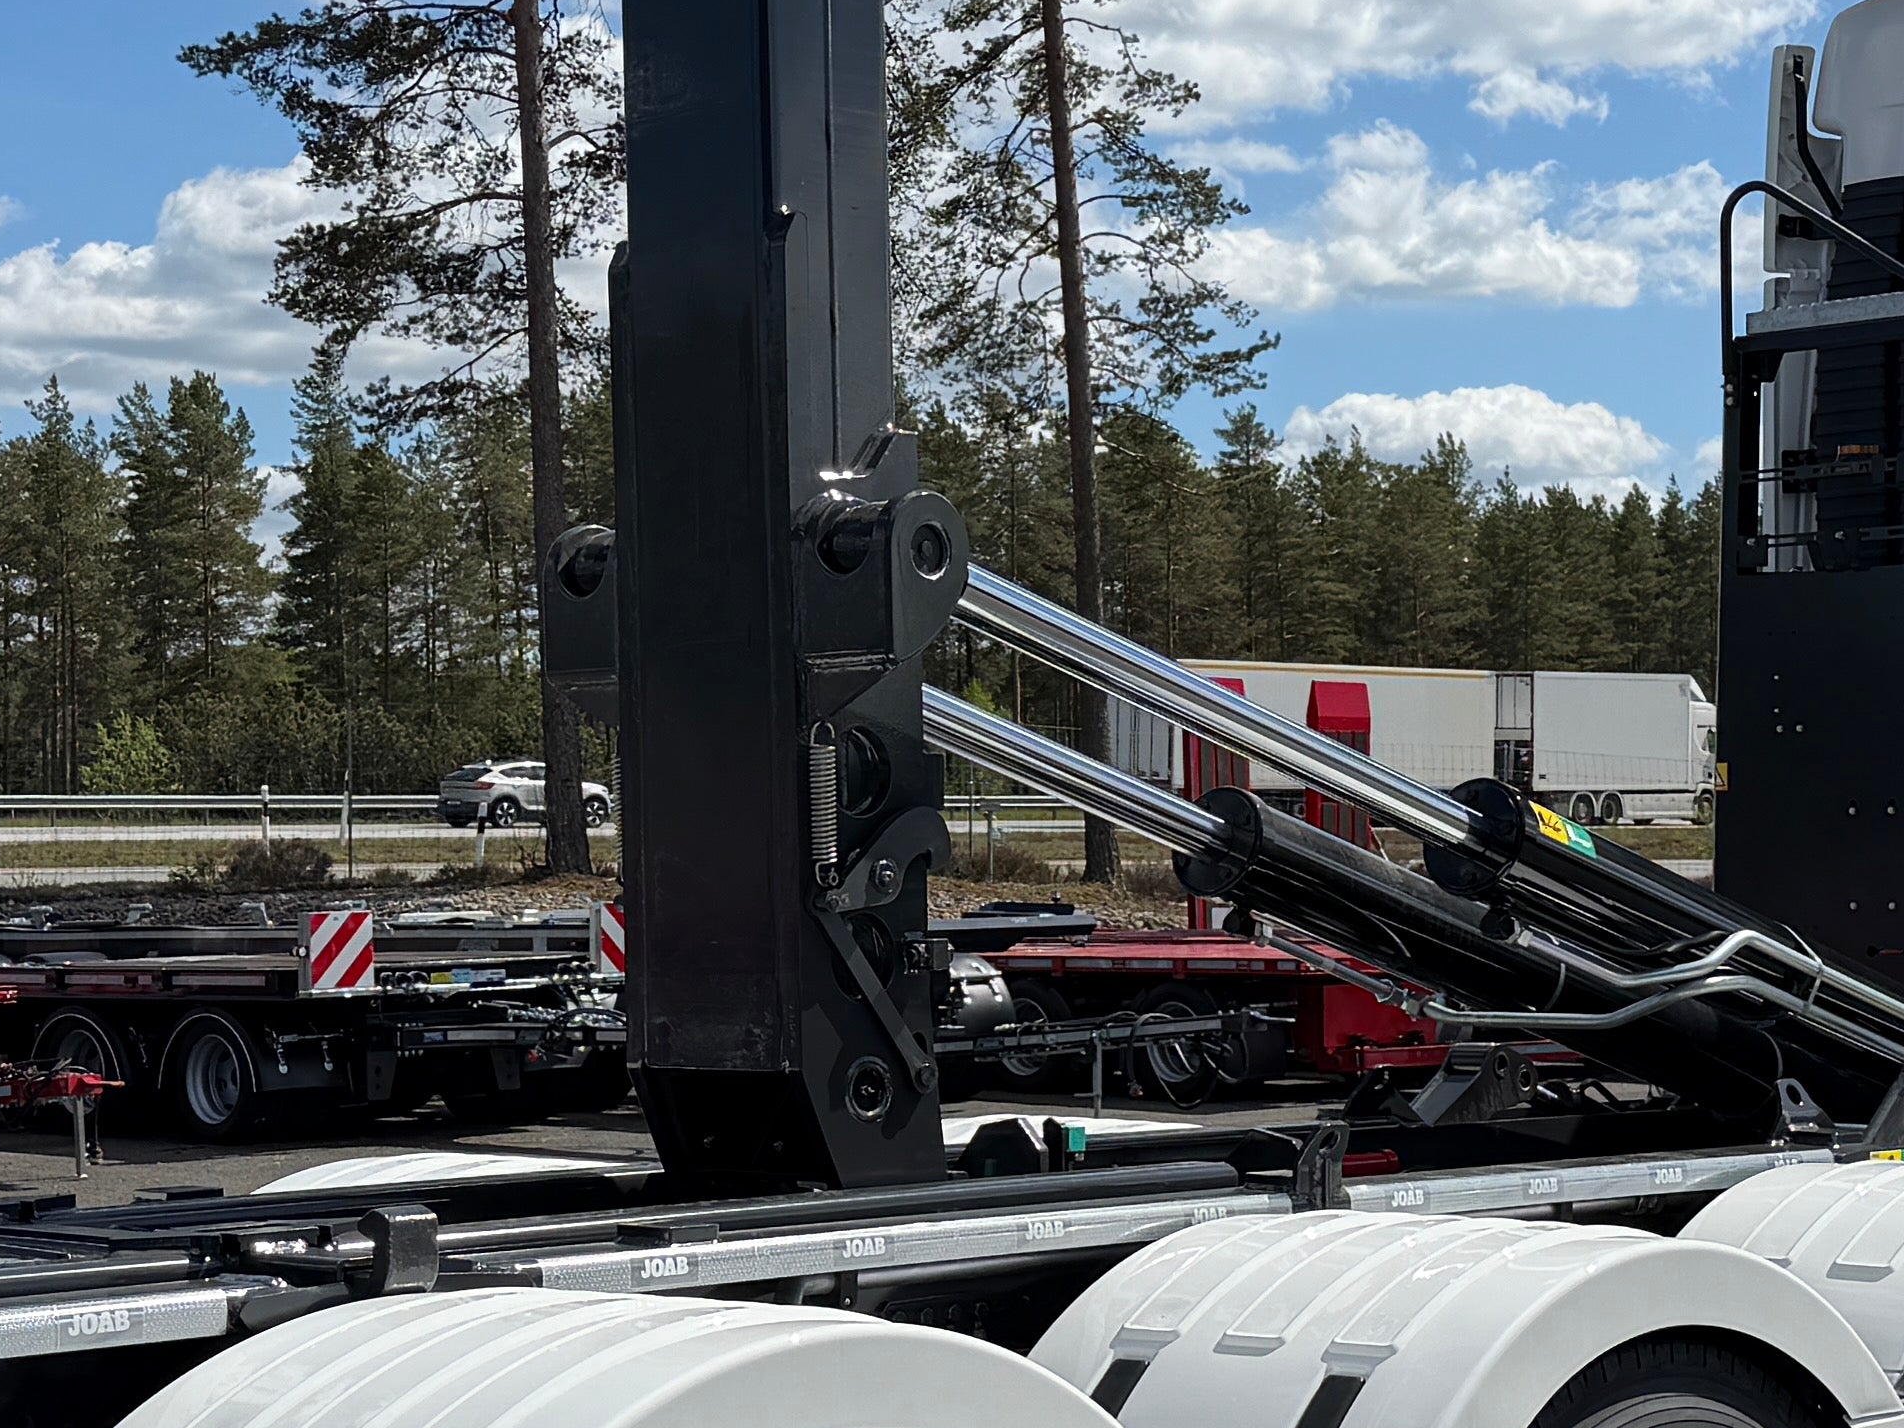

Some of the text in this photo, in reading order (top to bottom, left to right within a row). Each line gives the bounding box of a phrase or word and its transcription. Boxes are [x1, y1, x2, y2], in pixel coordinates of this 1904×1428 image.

[1528, 1177, 1558, 1194] JOAB
[1654, 1167, 1683, 1184] JOAB
[1391, 1189, 1424, 1207] JOAB
[1025, 1220, 1065, 1241] JOAB
[842, 1237, 885, 1259] JOAB
[641, 1256, 689, 1279] JOAB
[68, 1310, 130, 1336] JOAB
